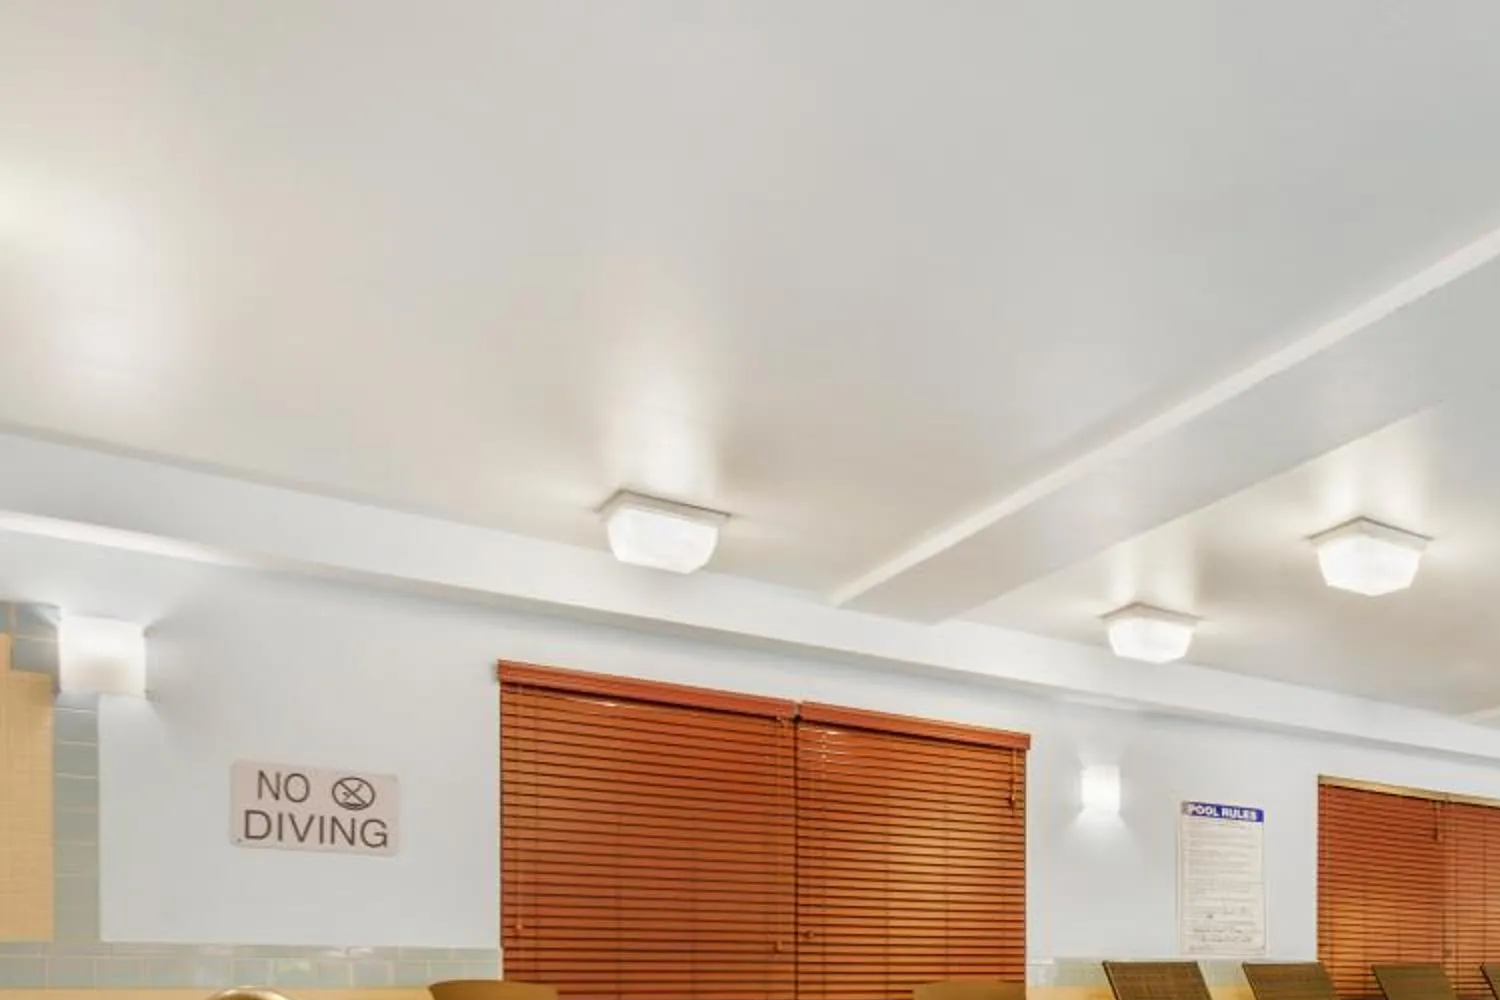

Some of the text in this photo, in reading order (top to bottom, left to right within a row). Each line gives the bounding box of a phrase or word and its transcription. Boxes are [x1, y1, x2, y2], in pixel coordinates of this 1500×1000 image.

[257, 770, 310, 803] NO
[1187, 803, 1257, 820] POOL RULES
[244, 809, 389, 848] DIVING
